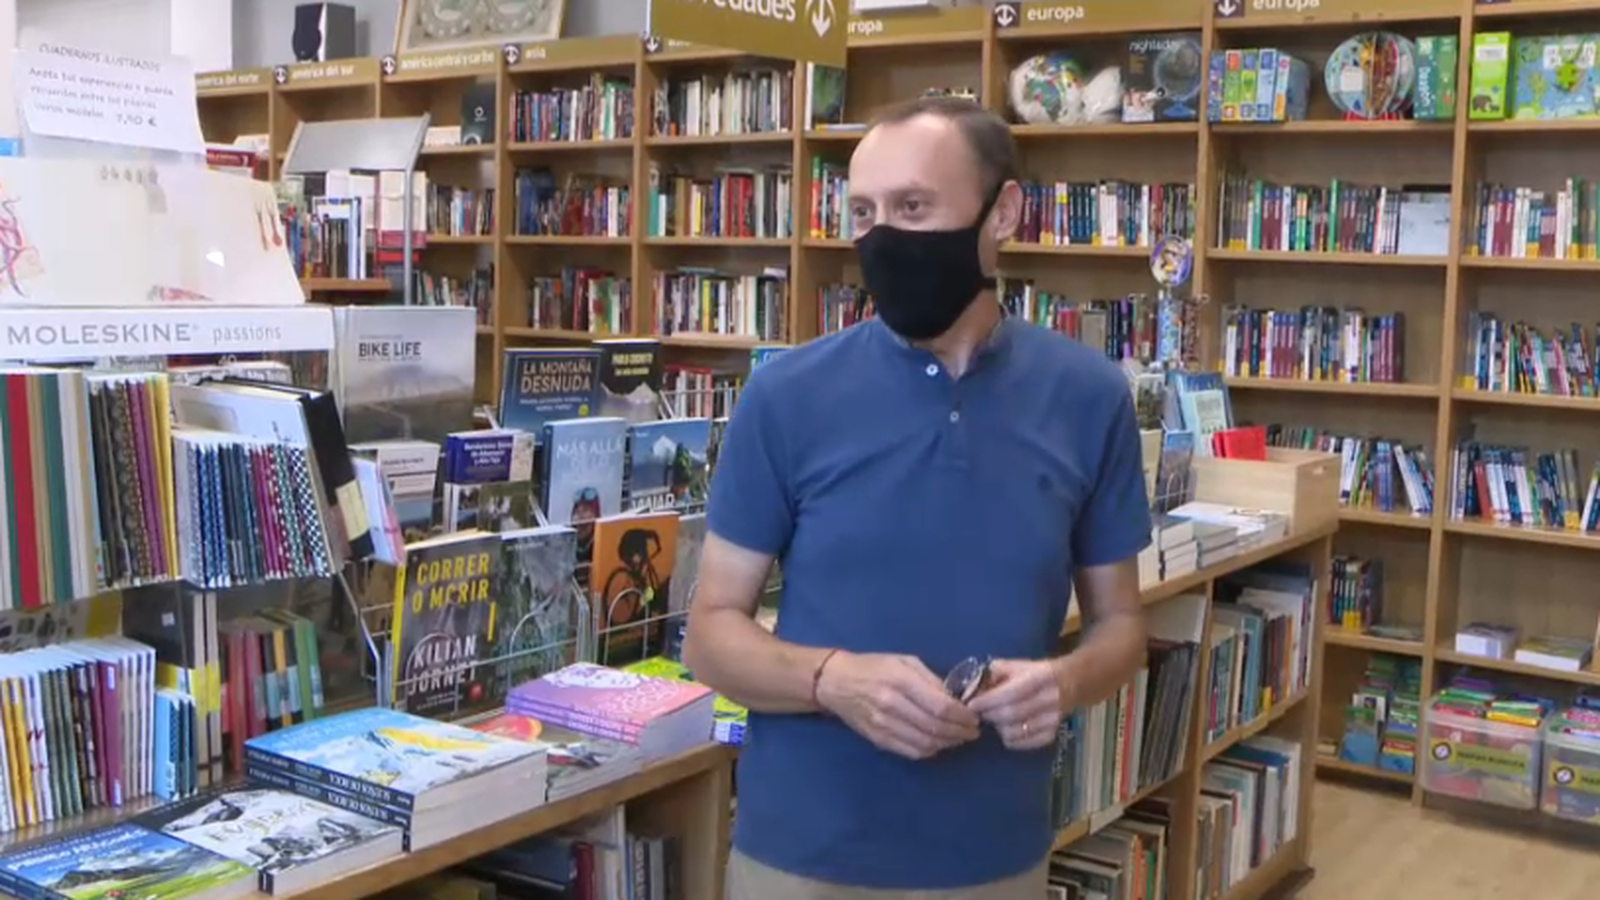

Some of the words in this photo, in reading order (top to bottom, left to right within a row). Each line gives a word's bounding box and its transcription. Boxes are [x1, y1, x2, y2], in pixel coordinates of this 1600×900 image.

[1027, 6, 1084, 22] europa
[525, 47, 546, 60] asia
[326, 65, 338, 77] del
[8, 323, 192, 345] MOLESKINE
[213, 325, 281, 345] passions
[359, 342, 390, 357] BIKE
[393, 341, 422, 356] LIFE
[522, 361, 538, 375] LA
[539, 358, 592, 374] MONTAÑA
[521, 376, 591, 394] DESNUDA
[556, 438, 587, 460] MÁS
[417, 552, 490, 585] CORRER
[411, 592, 422, 614] O
[414, 634, 477, 668] KILIAN
[408, 660, 478, 696] JORNET
